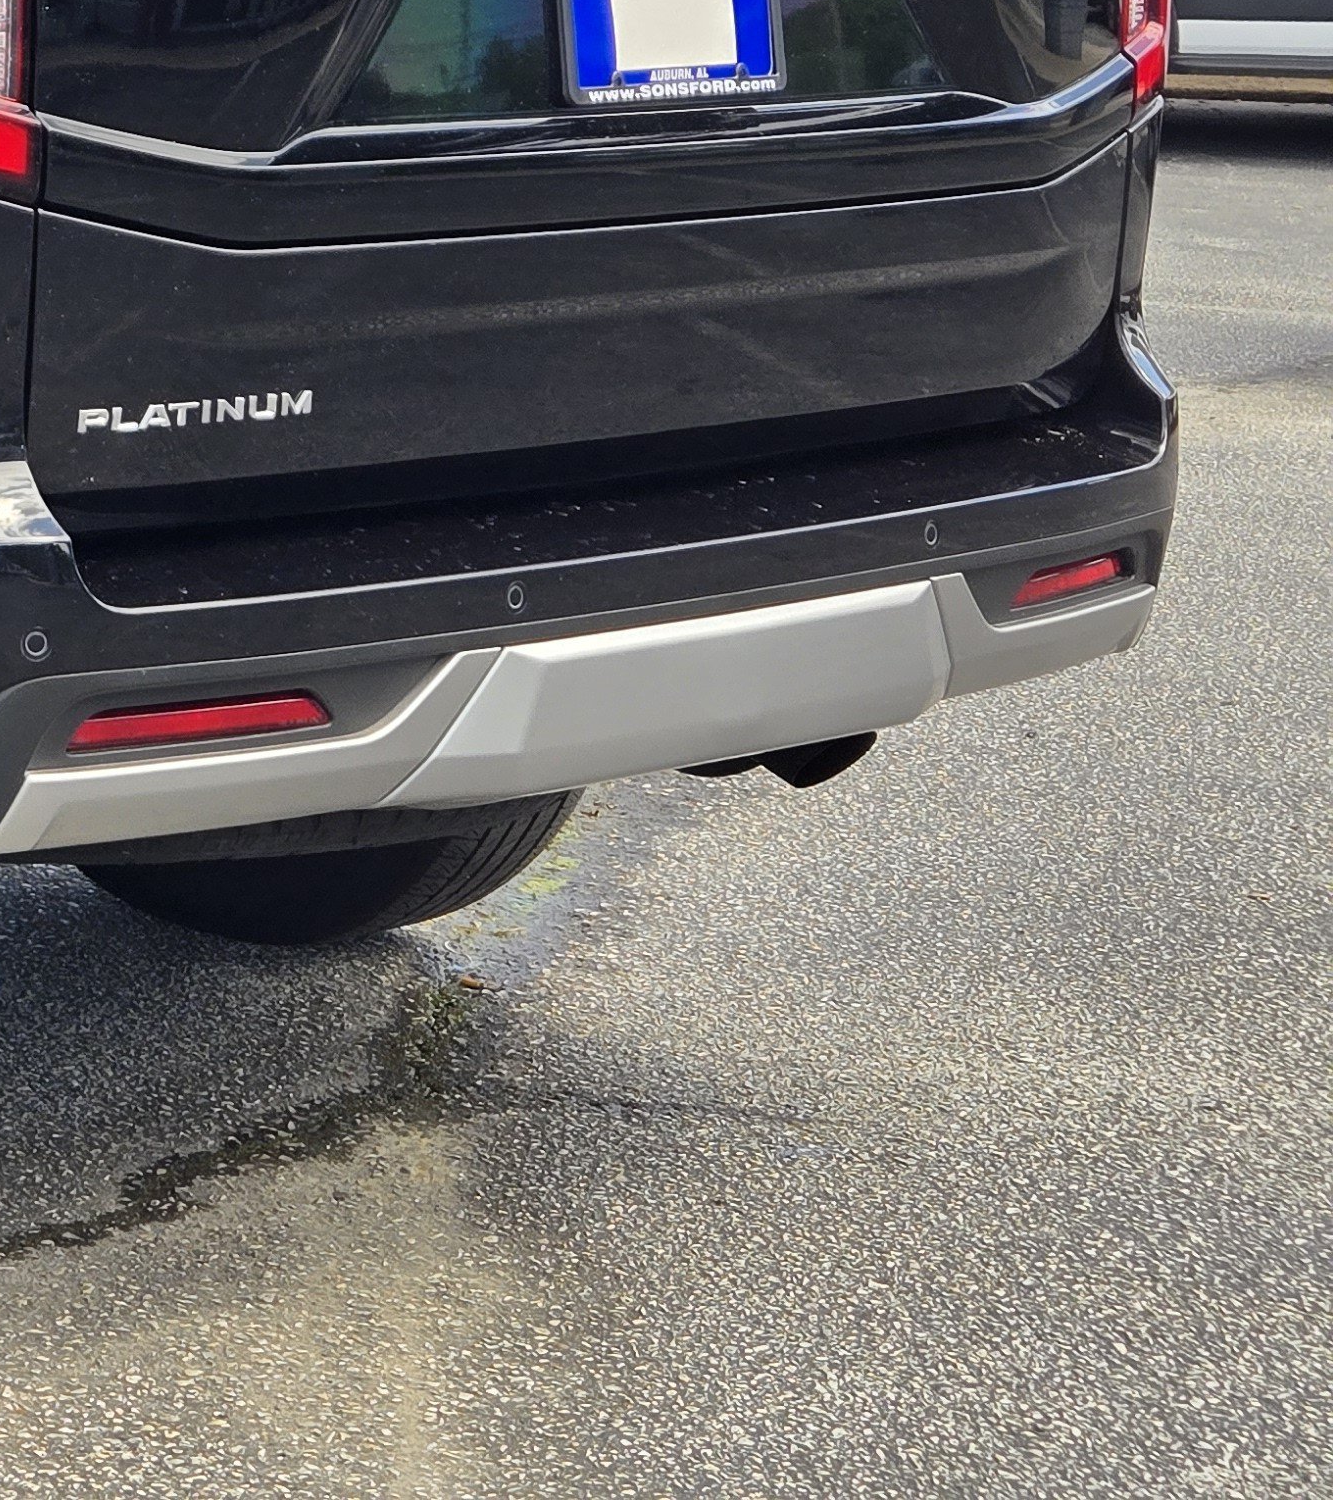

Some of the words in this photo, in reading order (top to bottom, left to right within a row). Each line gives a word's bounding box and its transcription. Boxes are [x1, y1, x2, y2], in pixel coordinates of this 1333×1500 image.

[649, 68, 694, 82] AUBURN,
[697, 67, 709, 79] AL
[589, 78, 776, 103] www.SONSFORD.com
[77, 390, 313, 434] PLATINUM
